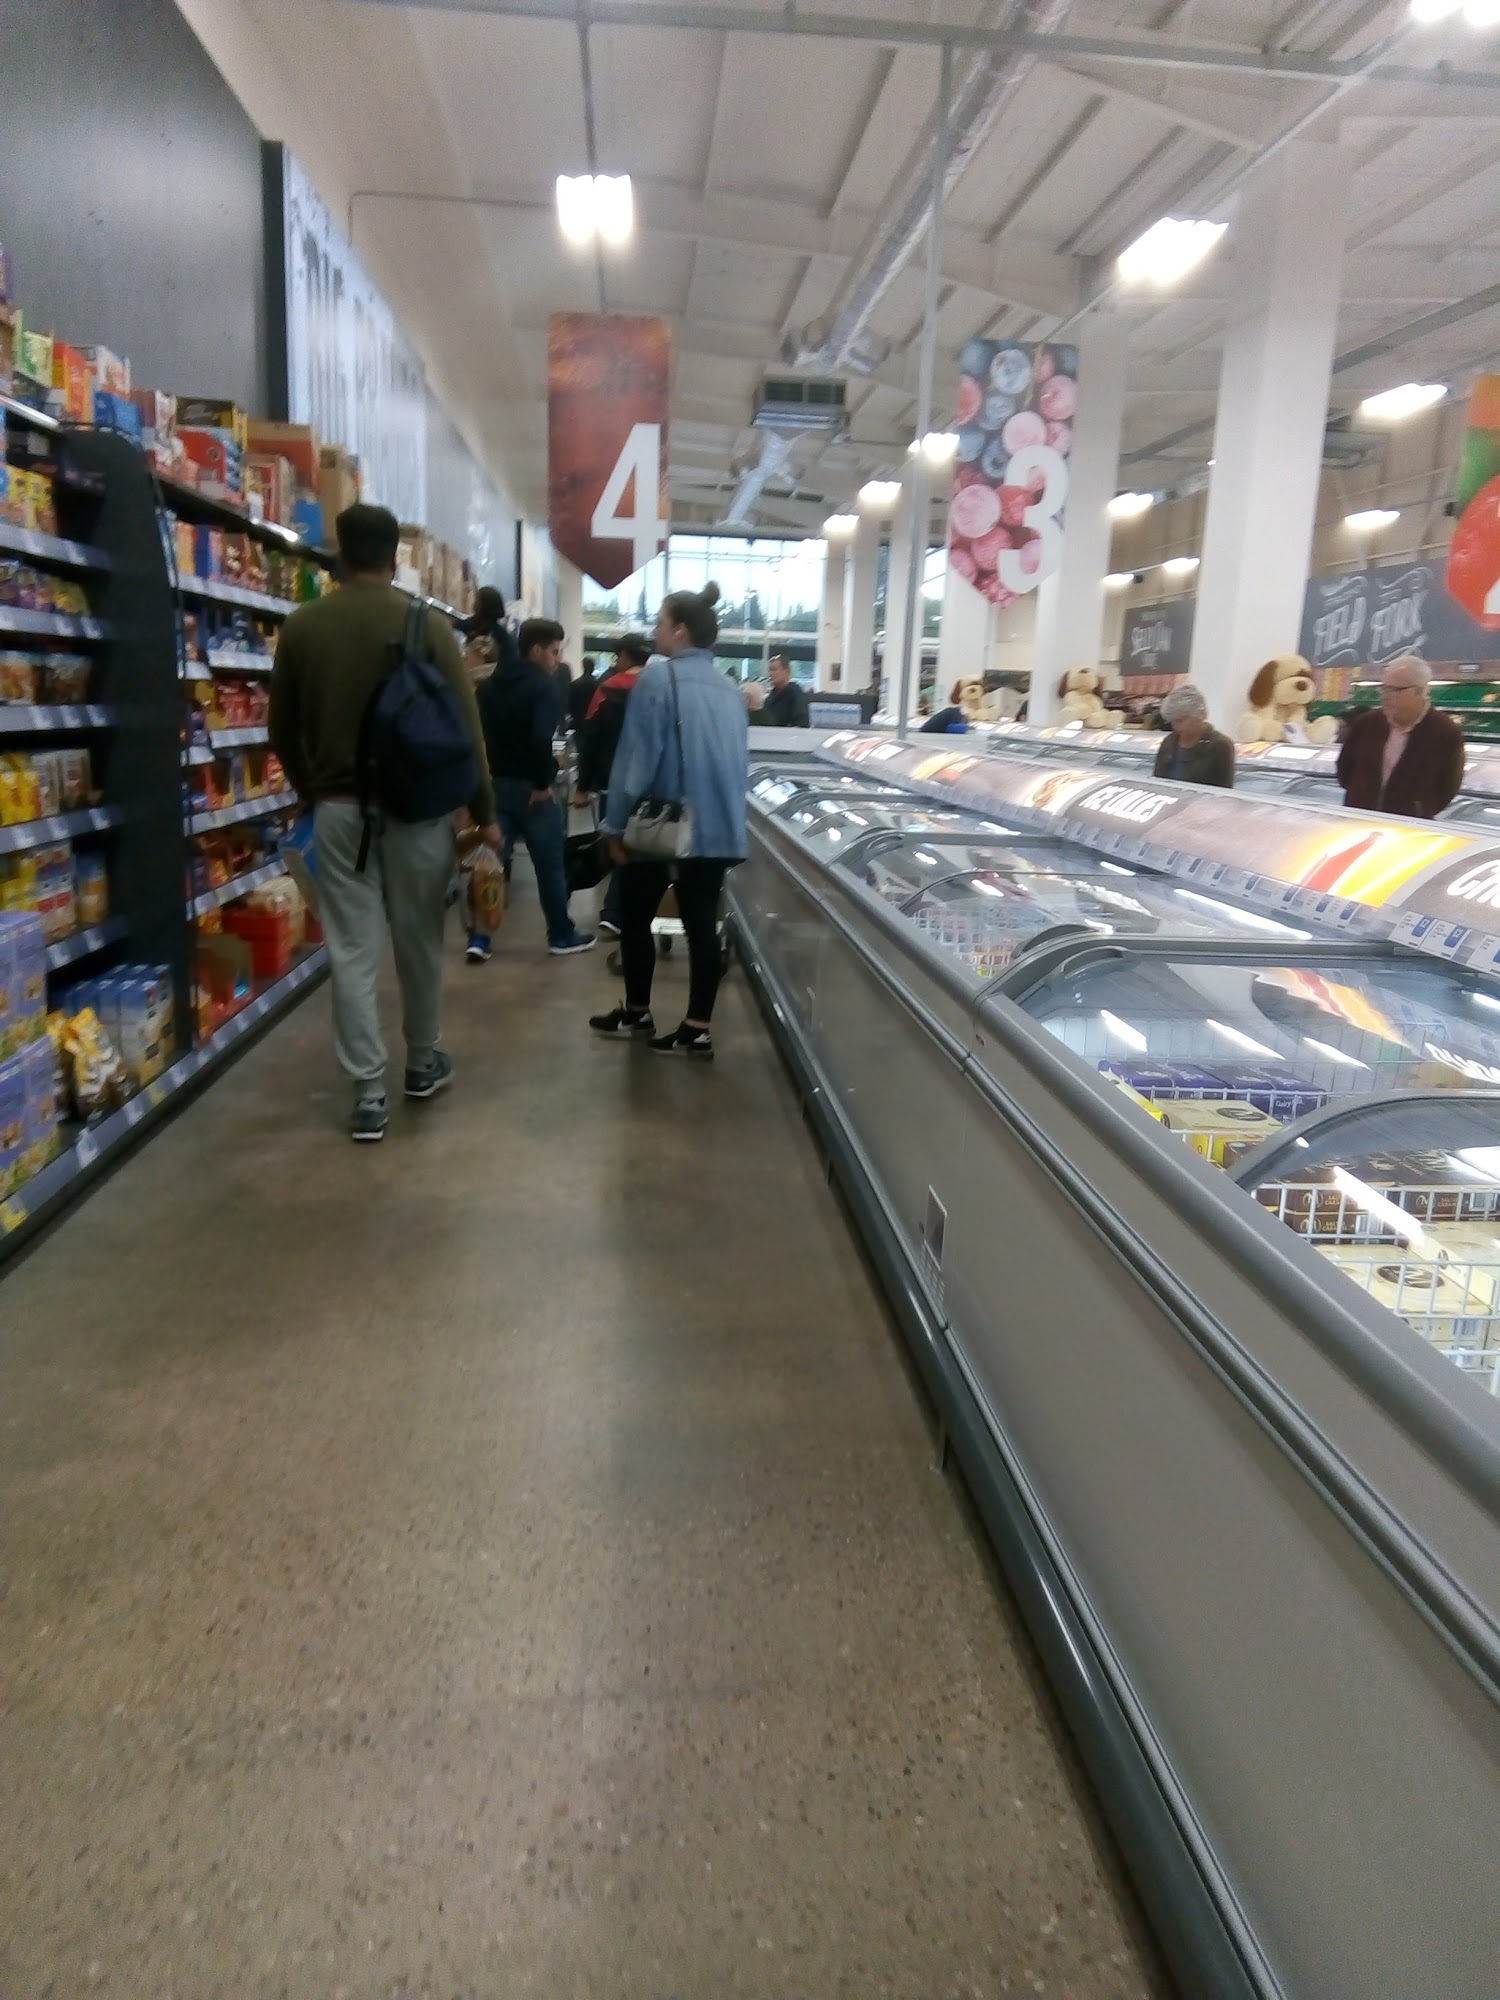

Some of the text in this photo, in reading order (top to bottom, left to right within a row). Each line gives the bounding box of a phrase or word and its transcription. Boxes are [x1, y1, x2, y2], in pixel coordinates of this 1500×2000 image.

[591, 423, 667, 572] 4
[998, 444, 1068, 594] 3
[1079, 785, 1179, 823] ICE LOLLIES
